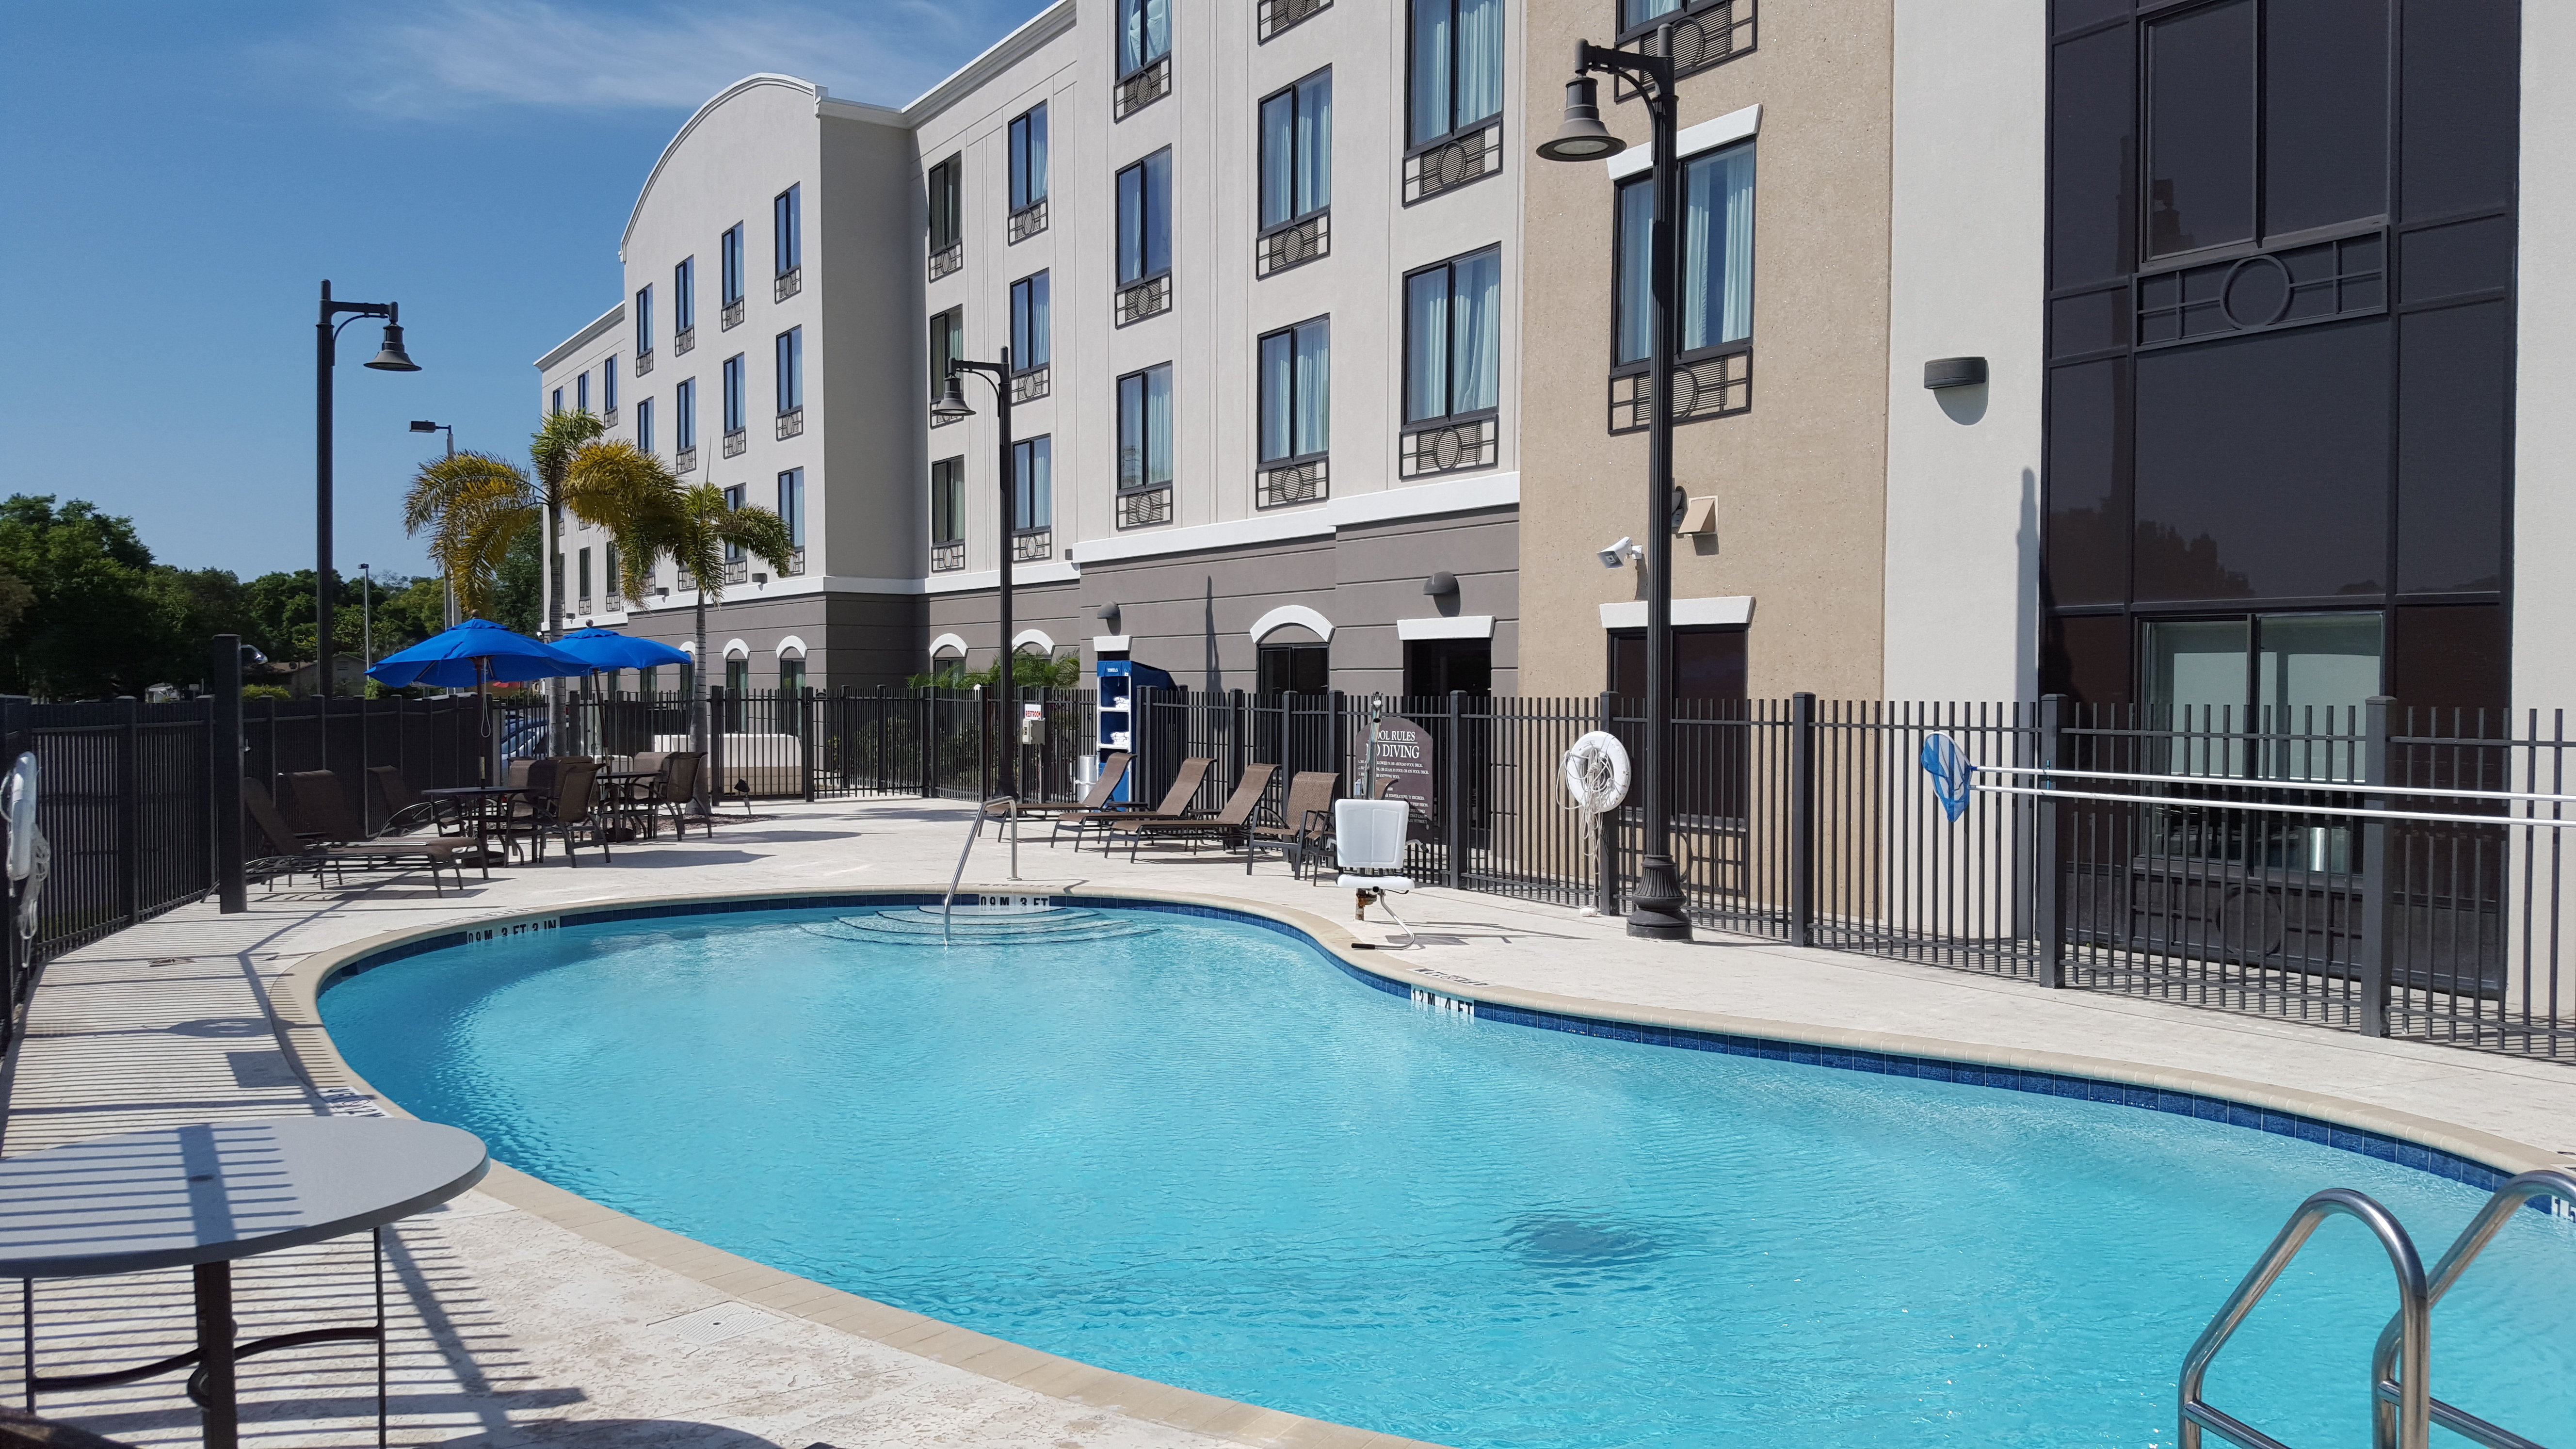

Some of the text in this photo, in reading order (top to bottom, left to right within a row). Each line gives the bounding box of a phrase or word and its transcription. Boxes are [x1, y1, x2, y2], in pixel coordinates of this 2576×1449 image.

[1391, 731, 1415, 741] RULES
[1383, 744, 1419, 759] DIVING
[1033, 898, 1048, 906] FT
[513, 924, 527, 935] FT
[544, 919, 556, 930] IN
[1445, 997, 1451, 1010] 4
[1458, 999, 1472, 1015] FT
